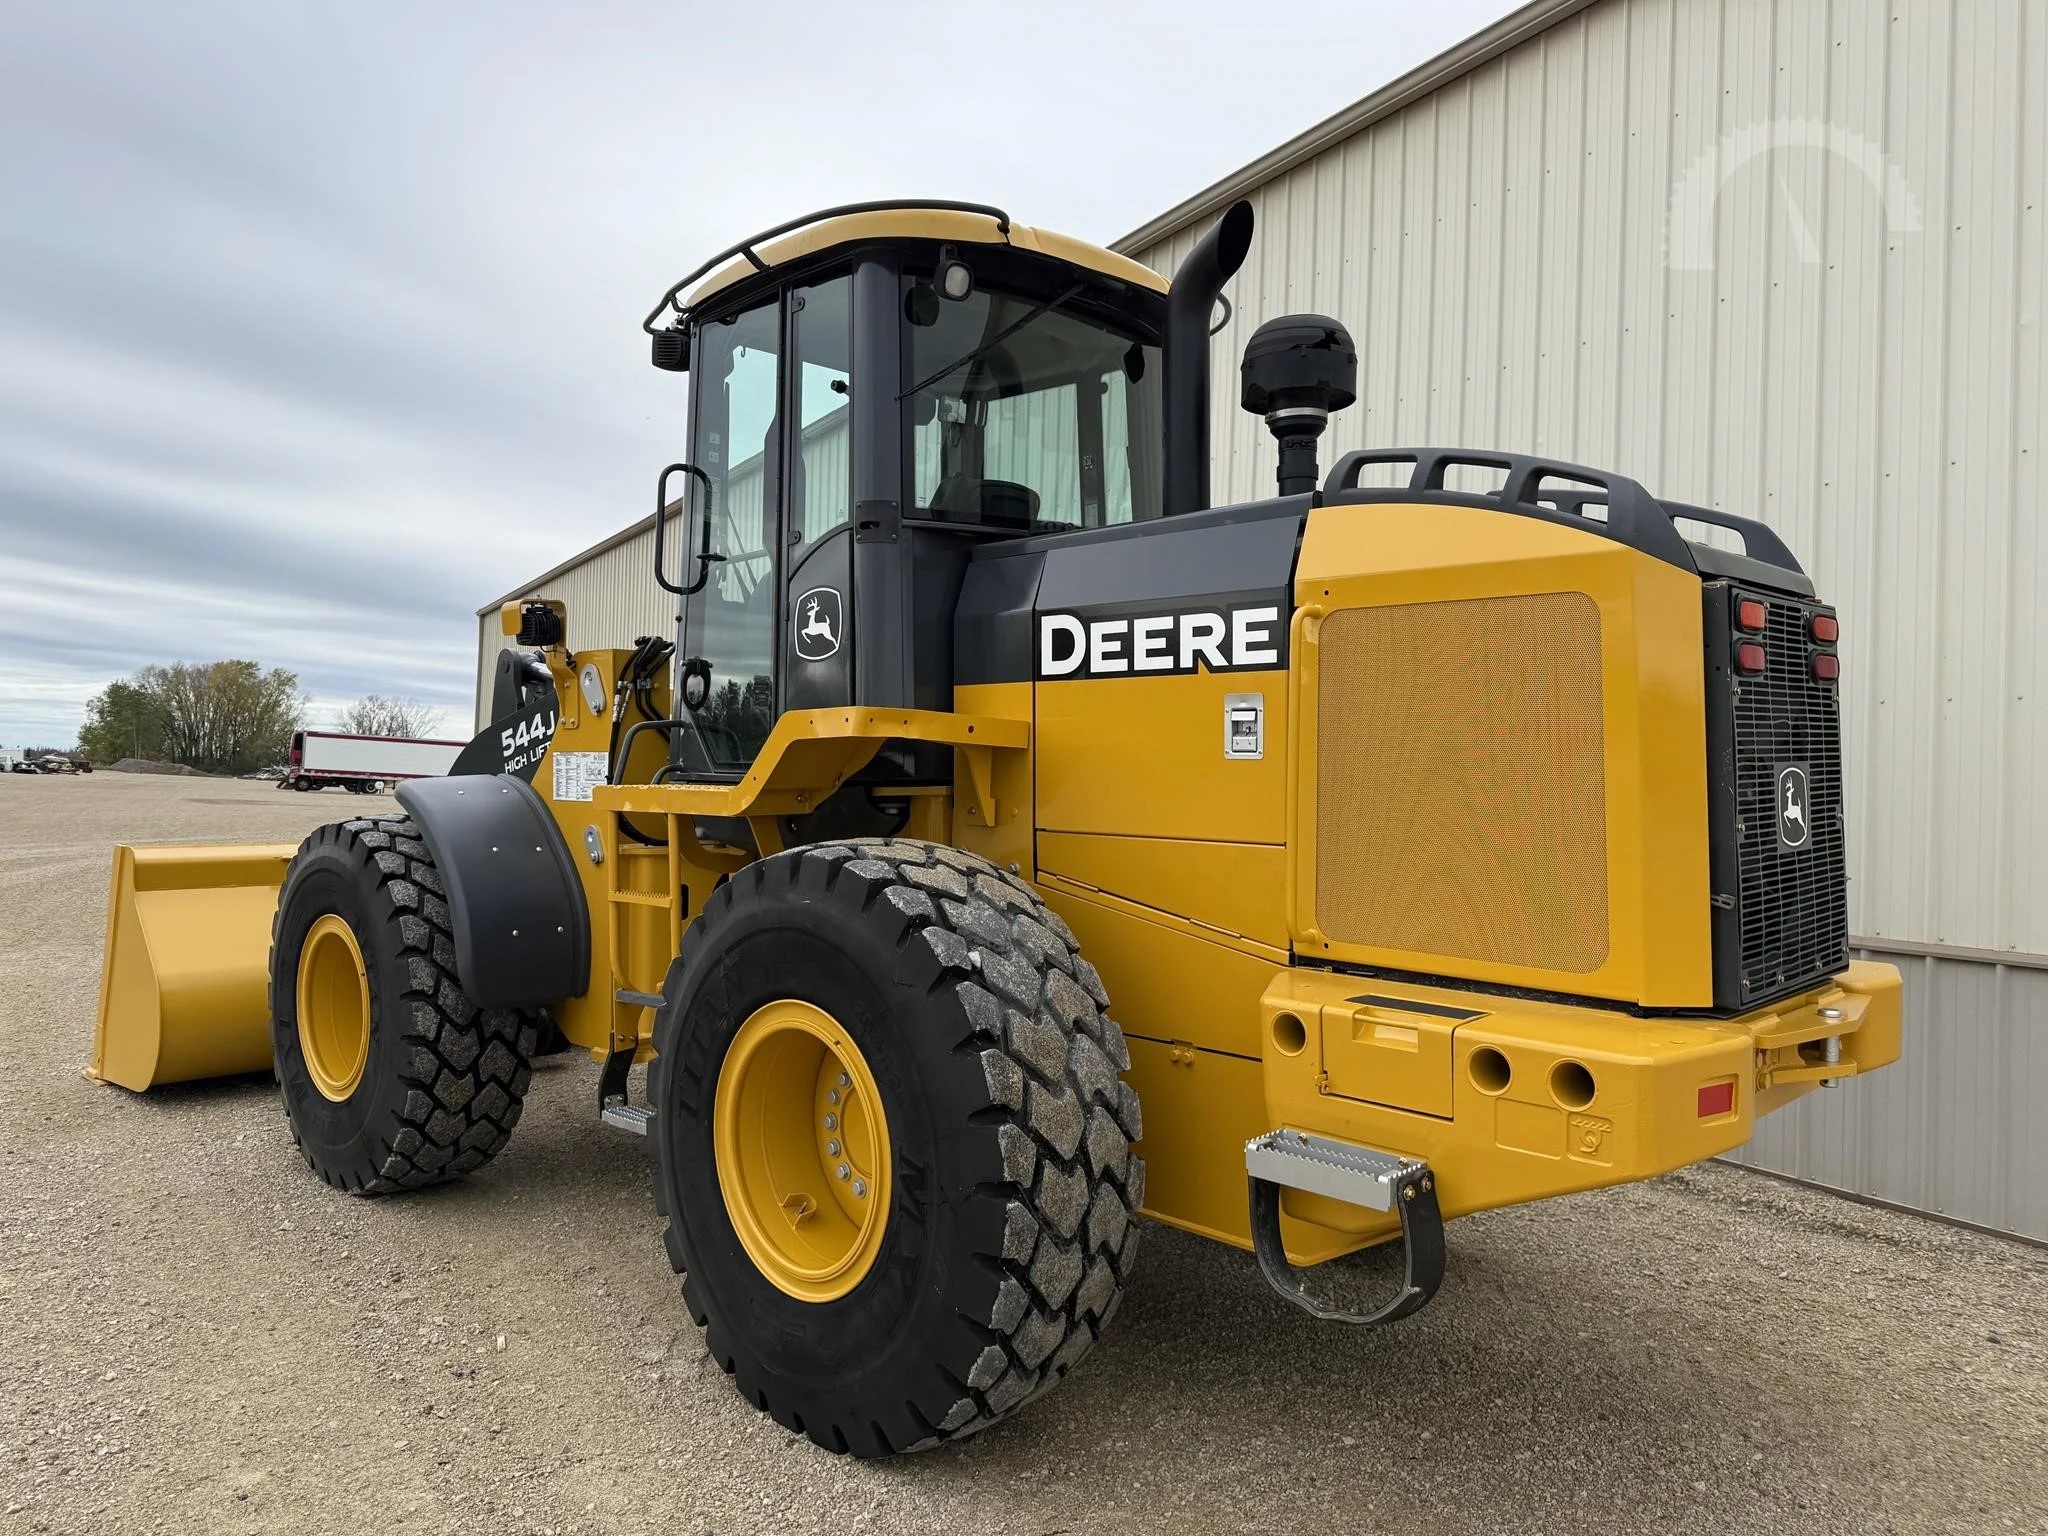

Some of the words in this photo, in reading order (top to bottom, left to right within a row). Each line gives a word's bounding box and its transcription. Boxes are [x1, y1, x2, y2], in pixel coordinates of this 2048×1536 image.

[1040, 607, 1278, 676] DEERE
[501, 710, 555, 757] 544J
[504, 753, 528, 774] HIGH
